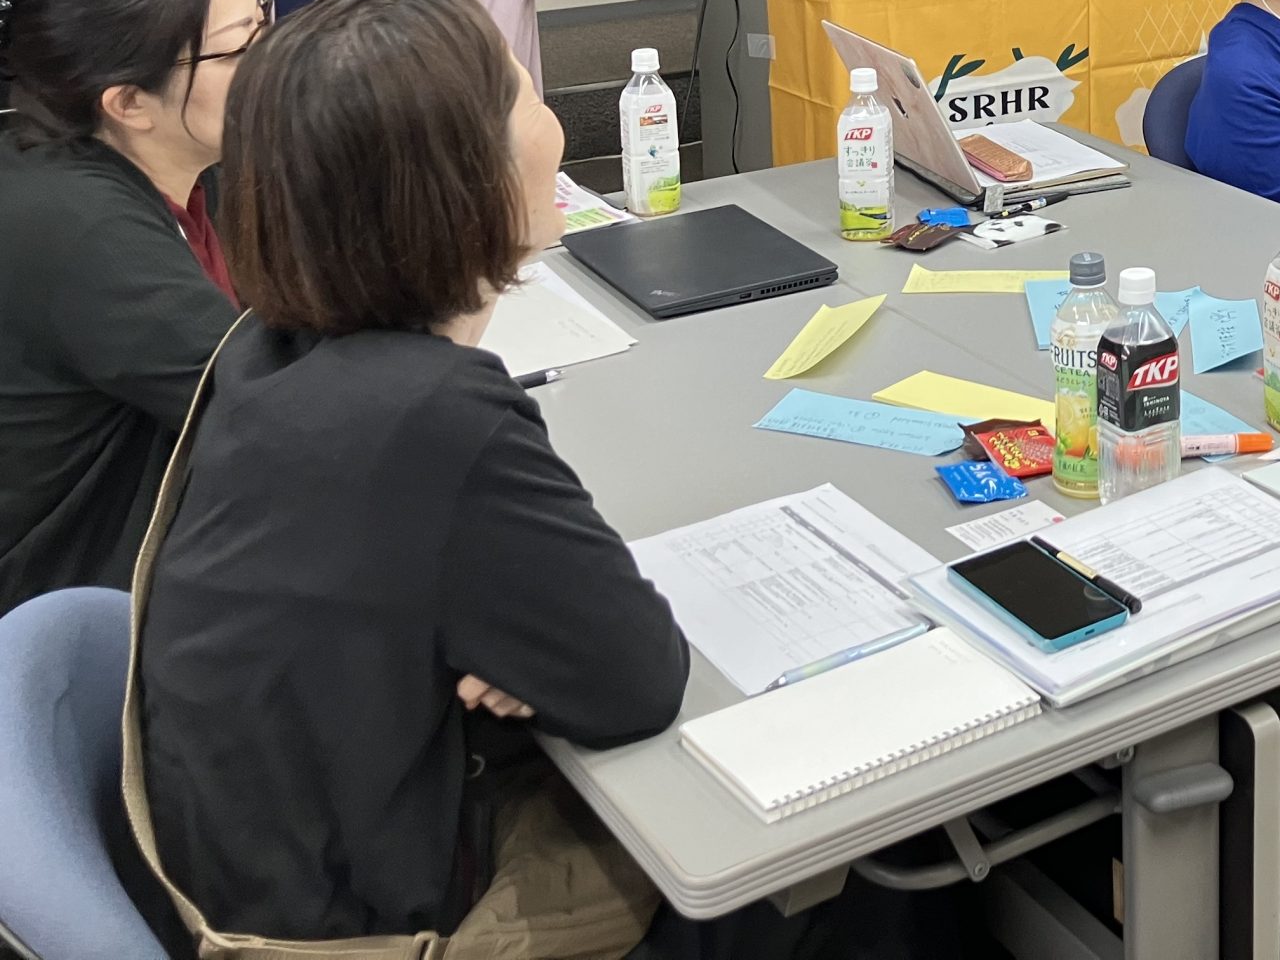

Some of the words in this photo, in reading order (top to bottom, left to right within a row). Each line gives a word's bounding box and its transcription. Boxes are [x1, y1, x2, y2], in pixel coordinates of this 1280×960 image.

[948, 85, 1050, 123] SRHR
[847, 129, 871, 140] TKP
[844, 145, 876, 157] すっきり
[1265, 282, 1280, 298] TKP
[1050, 343, 1097, 368] RUITS
[1102, 353, 1116, 365] TKP
[1068, 368, 1091, 377] TEA
[1133, 355, 1178, 386] TKP
